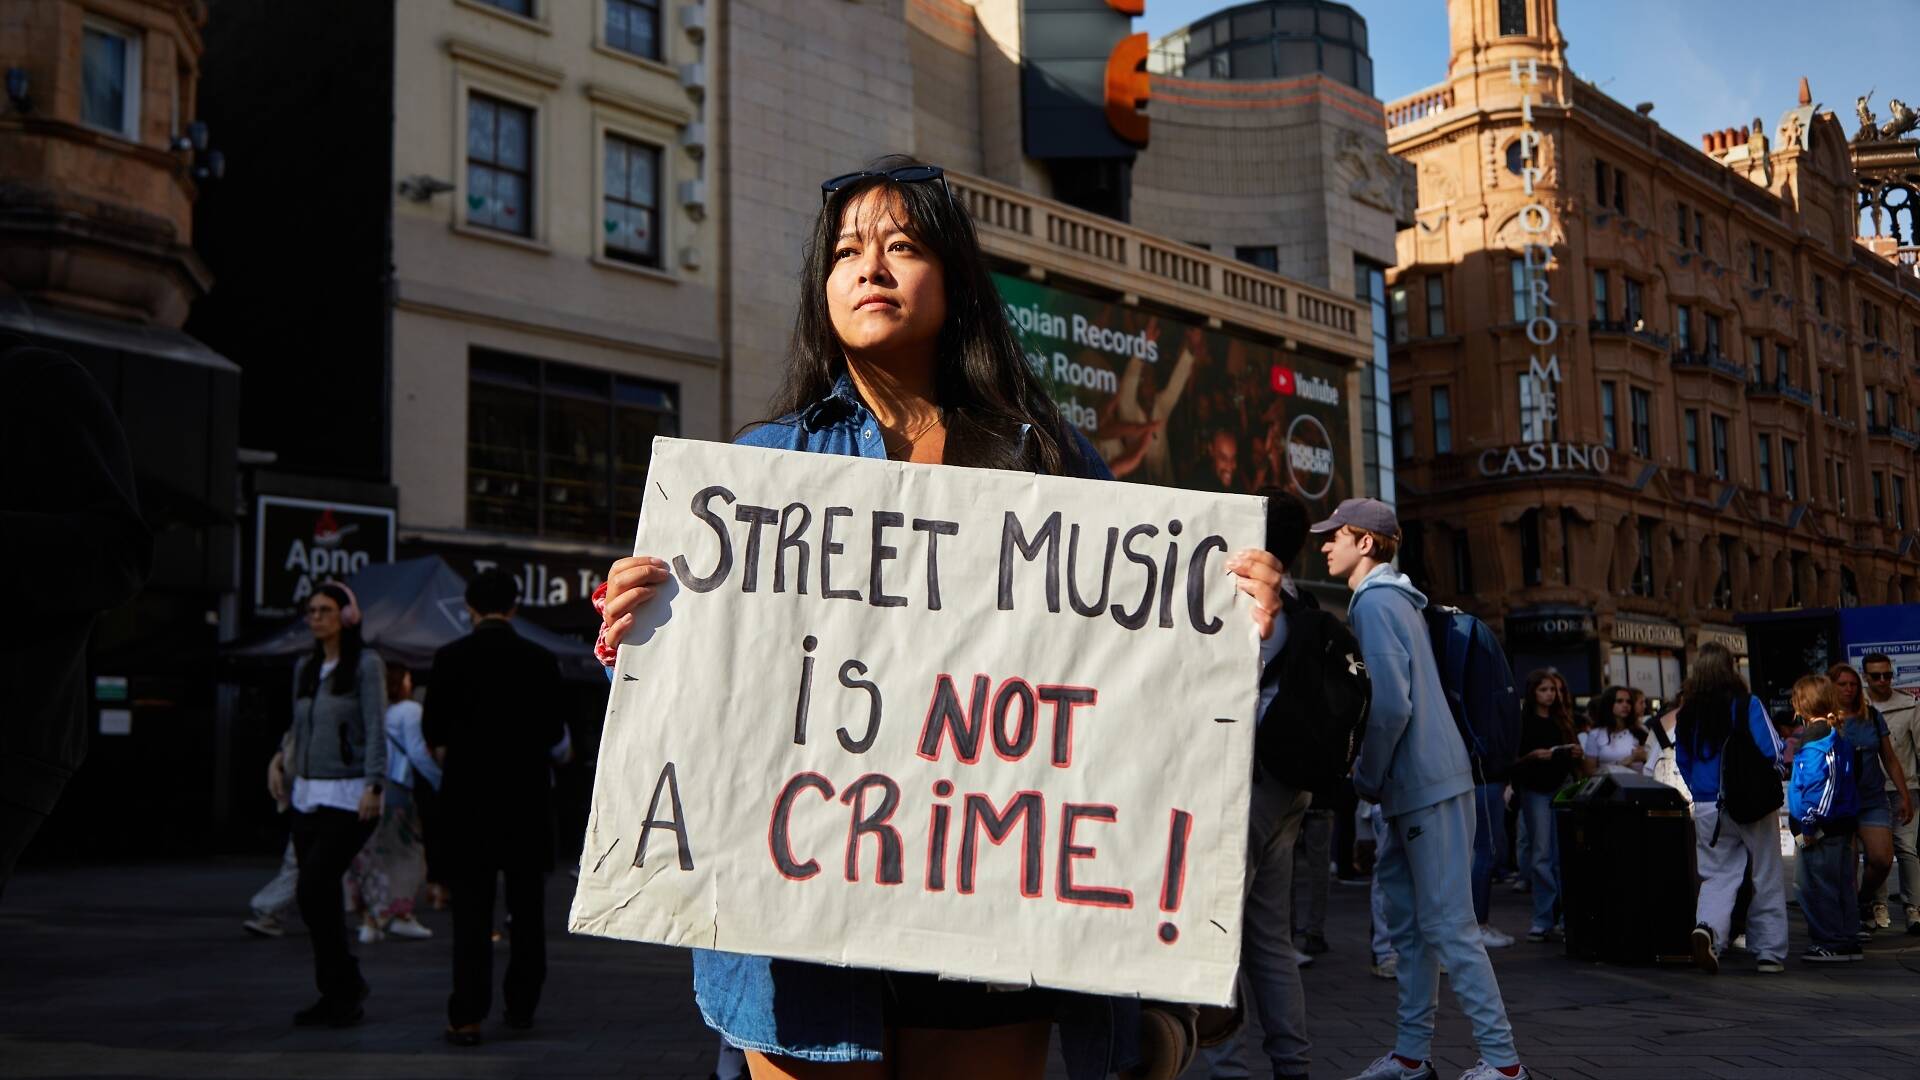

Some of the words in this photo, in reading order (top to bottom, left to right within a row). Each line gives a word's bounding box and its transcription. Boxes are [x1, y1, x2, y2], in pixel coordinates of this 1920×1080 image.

[1509, 58, 1562, 421] HIPPODROME
[1071, 312, 1160, 364] Records
[1053, 351, 1118, 394] Room
[1294, 370, 1340, 408] YouTube
[1478, 442, 1610, 478] CASINO
[673, 486, 958, 611] STREET
[1861, 646, 1882, 655] WEST
[1883, 645, 1901, 654] END
[916, 673, 1098, 768] NOT
[632, 761, 694, 871] A
